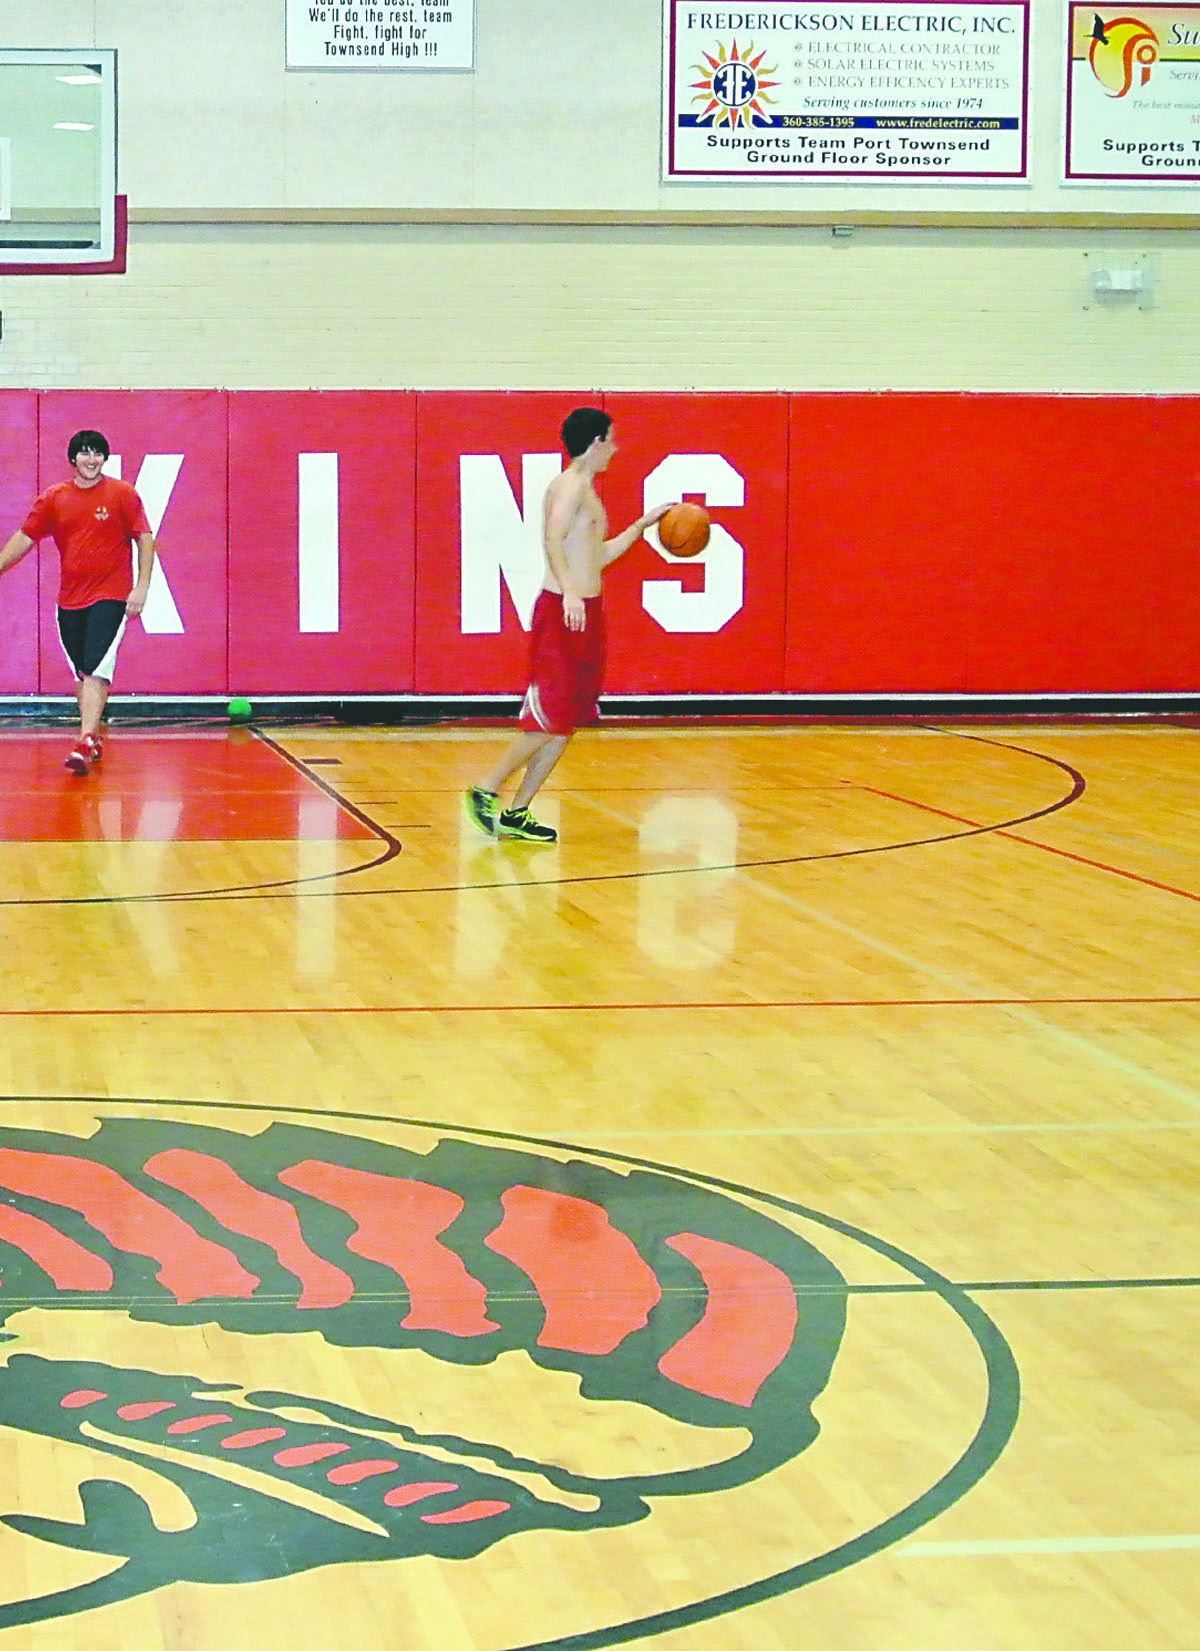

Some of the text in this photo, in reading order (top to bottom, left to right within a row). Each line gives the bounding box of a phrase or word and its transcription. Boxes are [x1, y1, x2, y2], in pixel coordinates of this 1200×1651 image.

[309, 8, 452, 23] We'll do the rest, team
[687, 13, 1015, 35] FREDERICKSON ELECTRIC, INC.
[334, 25, 427, 41] Fight, fight for
[324, 41, 438, 58] Townsend High !!!
[808, 42, 1000, 55] ELECTRICAL CONTRACTOR
[808, 58, 995, 71] SOLAR ELECTRIC SYSTEMS
[809, 75, 865, 87] ENERGY
[951, 77, 1009, 89] EXPERTS
[803, 96, 983, 110] Serving customers since 1974
[782, 117, 1000, 129] 360-385-1395 www.fredelectric.com
[707, 135, 990, 150] Supports Team Port Townsend
[1103, 139, 1184, 153] Supports
[747, 151, 951, 166] Ground Floor Sponsor
[1142, 155, 1200, 166] Groun
